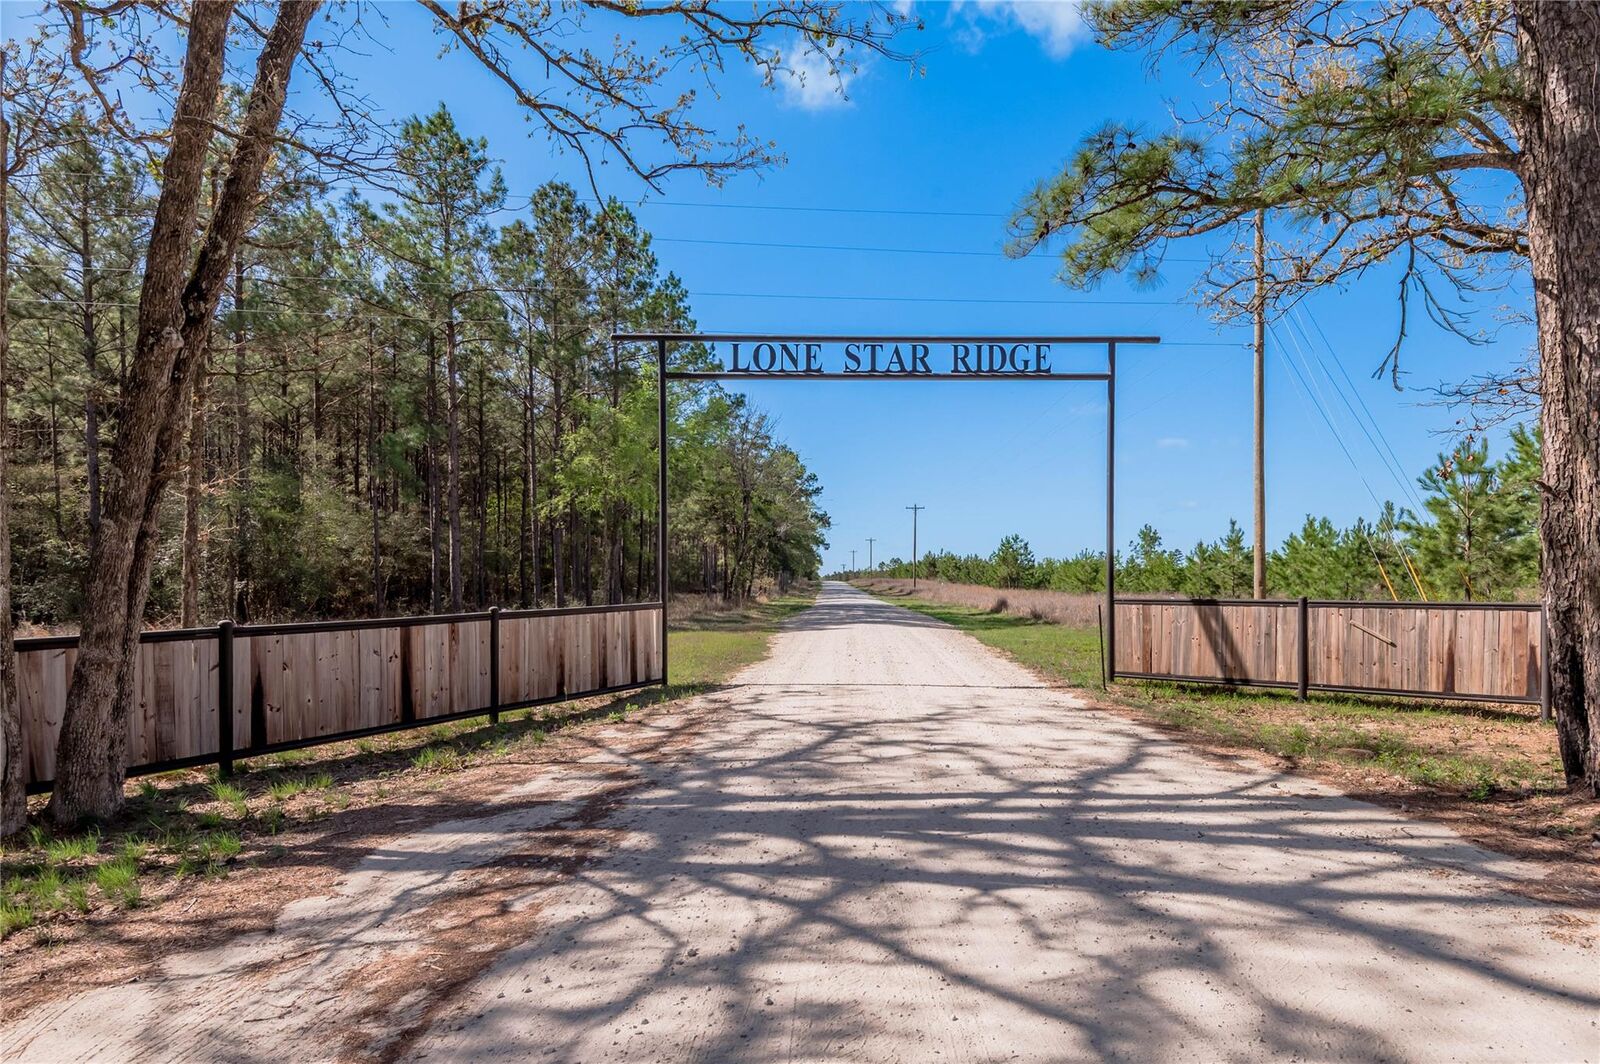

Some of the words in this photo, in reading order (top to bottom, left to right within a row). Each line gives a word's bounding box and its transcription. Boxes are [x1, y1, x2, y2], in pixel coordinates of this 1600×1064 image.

[731, 343, 823, 373] LONE
[844, 343, 933, 373] STAR
[952, 344, 1052, 374] RIDGE
